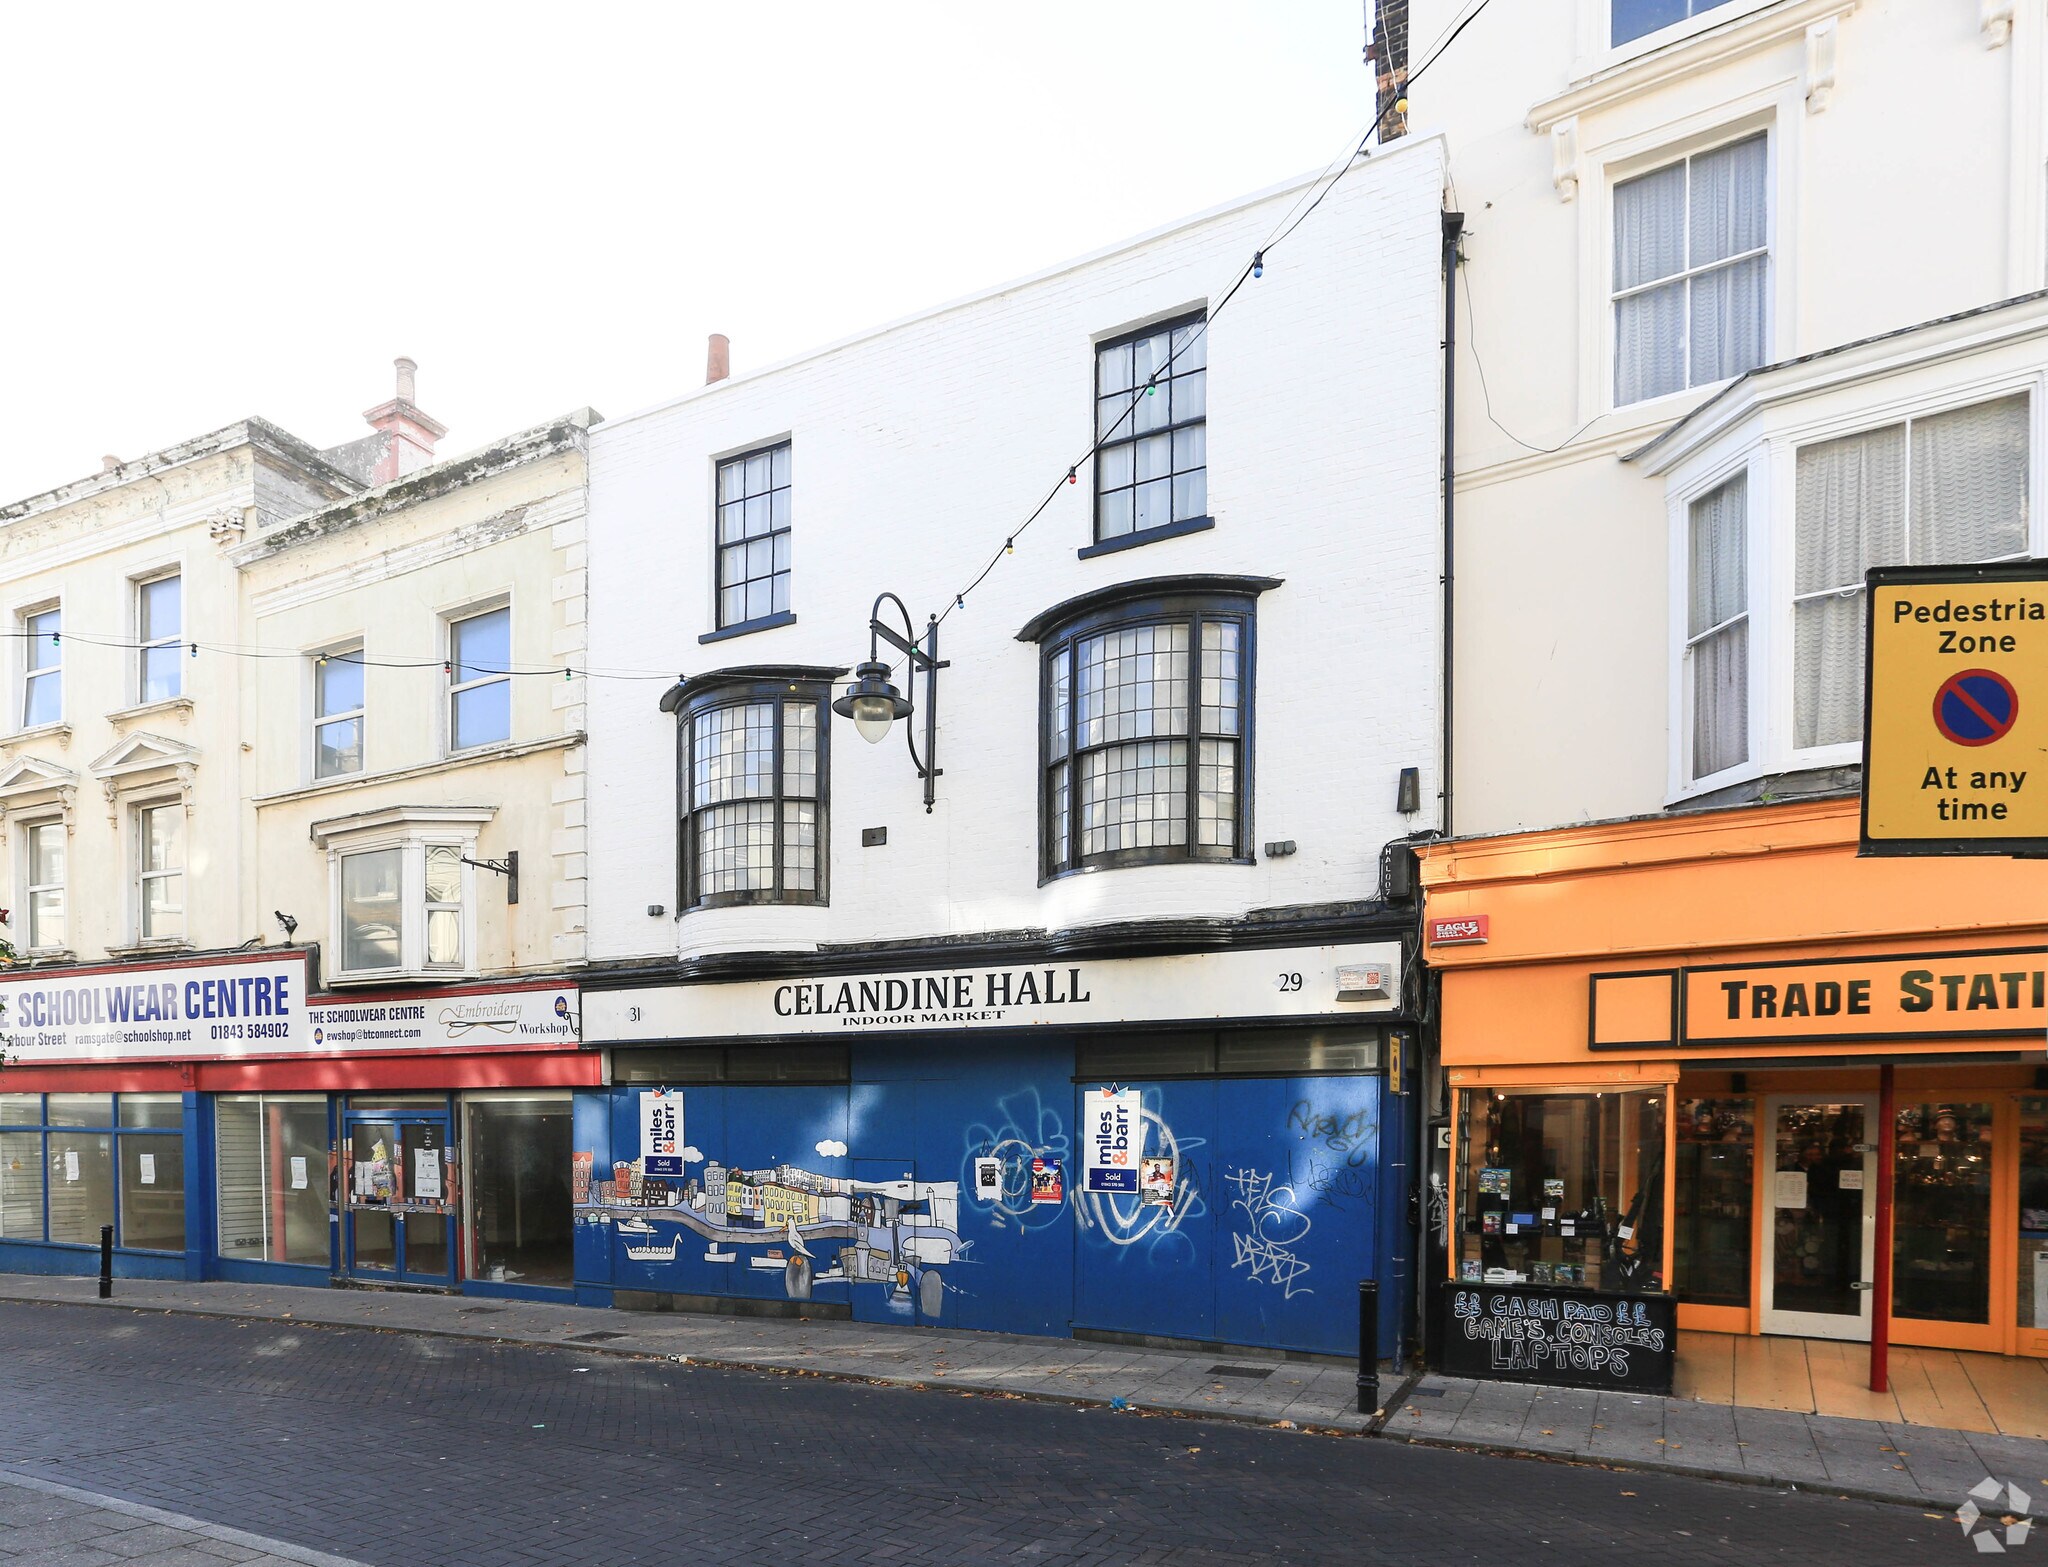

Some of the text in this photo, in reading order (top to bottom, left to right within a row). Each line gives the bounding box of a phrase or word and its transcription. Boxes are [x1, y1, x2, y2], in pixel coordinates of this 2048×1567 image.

[1894, 597, 2046, 624] Pedestria
[1938, 630, 2016, 654] Zone
[1920, 766, 2027, 793] At any
[1937, 798, 2008, 821] time
[1436, 921, 1477, 931] EAGLE
[774, 968, 1091, 1016] CELANDINE HALL
[1278, 972, 1303, 992] 29
[1721, 969, 2046, 1020] TRADE STATI
[18, 982, 178, 1028] SCHOOLWEAR
[184, 975, 290, 1020] CENTRE
[308, 1000, 524, 1024] THE SCHOOLWEAR CENTRE Embroidery
[630, 1007, 641, 1022] 31
[842, 1010, 1006, 1026] INDOOR MARKET
[38, 1031, 67, 1046] Street
[75, 1028, 192, 1046] ramsgate@schoolshop.net
[210, 1023, 244, 1040] 01843
[247, 1021, 290, 1039] 584902
[326, 1022, 569, 1042] ewshop@btconnect.com Workshop
[650, 1108, 662, 1153] miles
[1096, 1110, 1112, 1165] miles
[1105, 1172, 1121, 1181] Sold
[1490, 1295, 1559, 1320] CASH
[1563, 1300, 1613, 1323] PAID
[1556, 1321, 1664, 1351] CONSOLES
[1491, 1337, 1629, 1377] LAPTOPS
